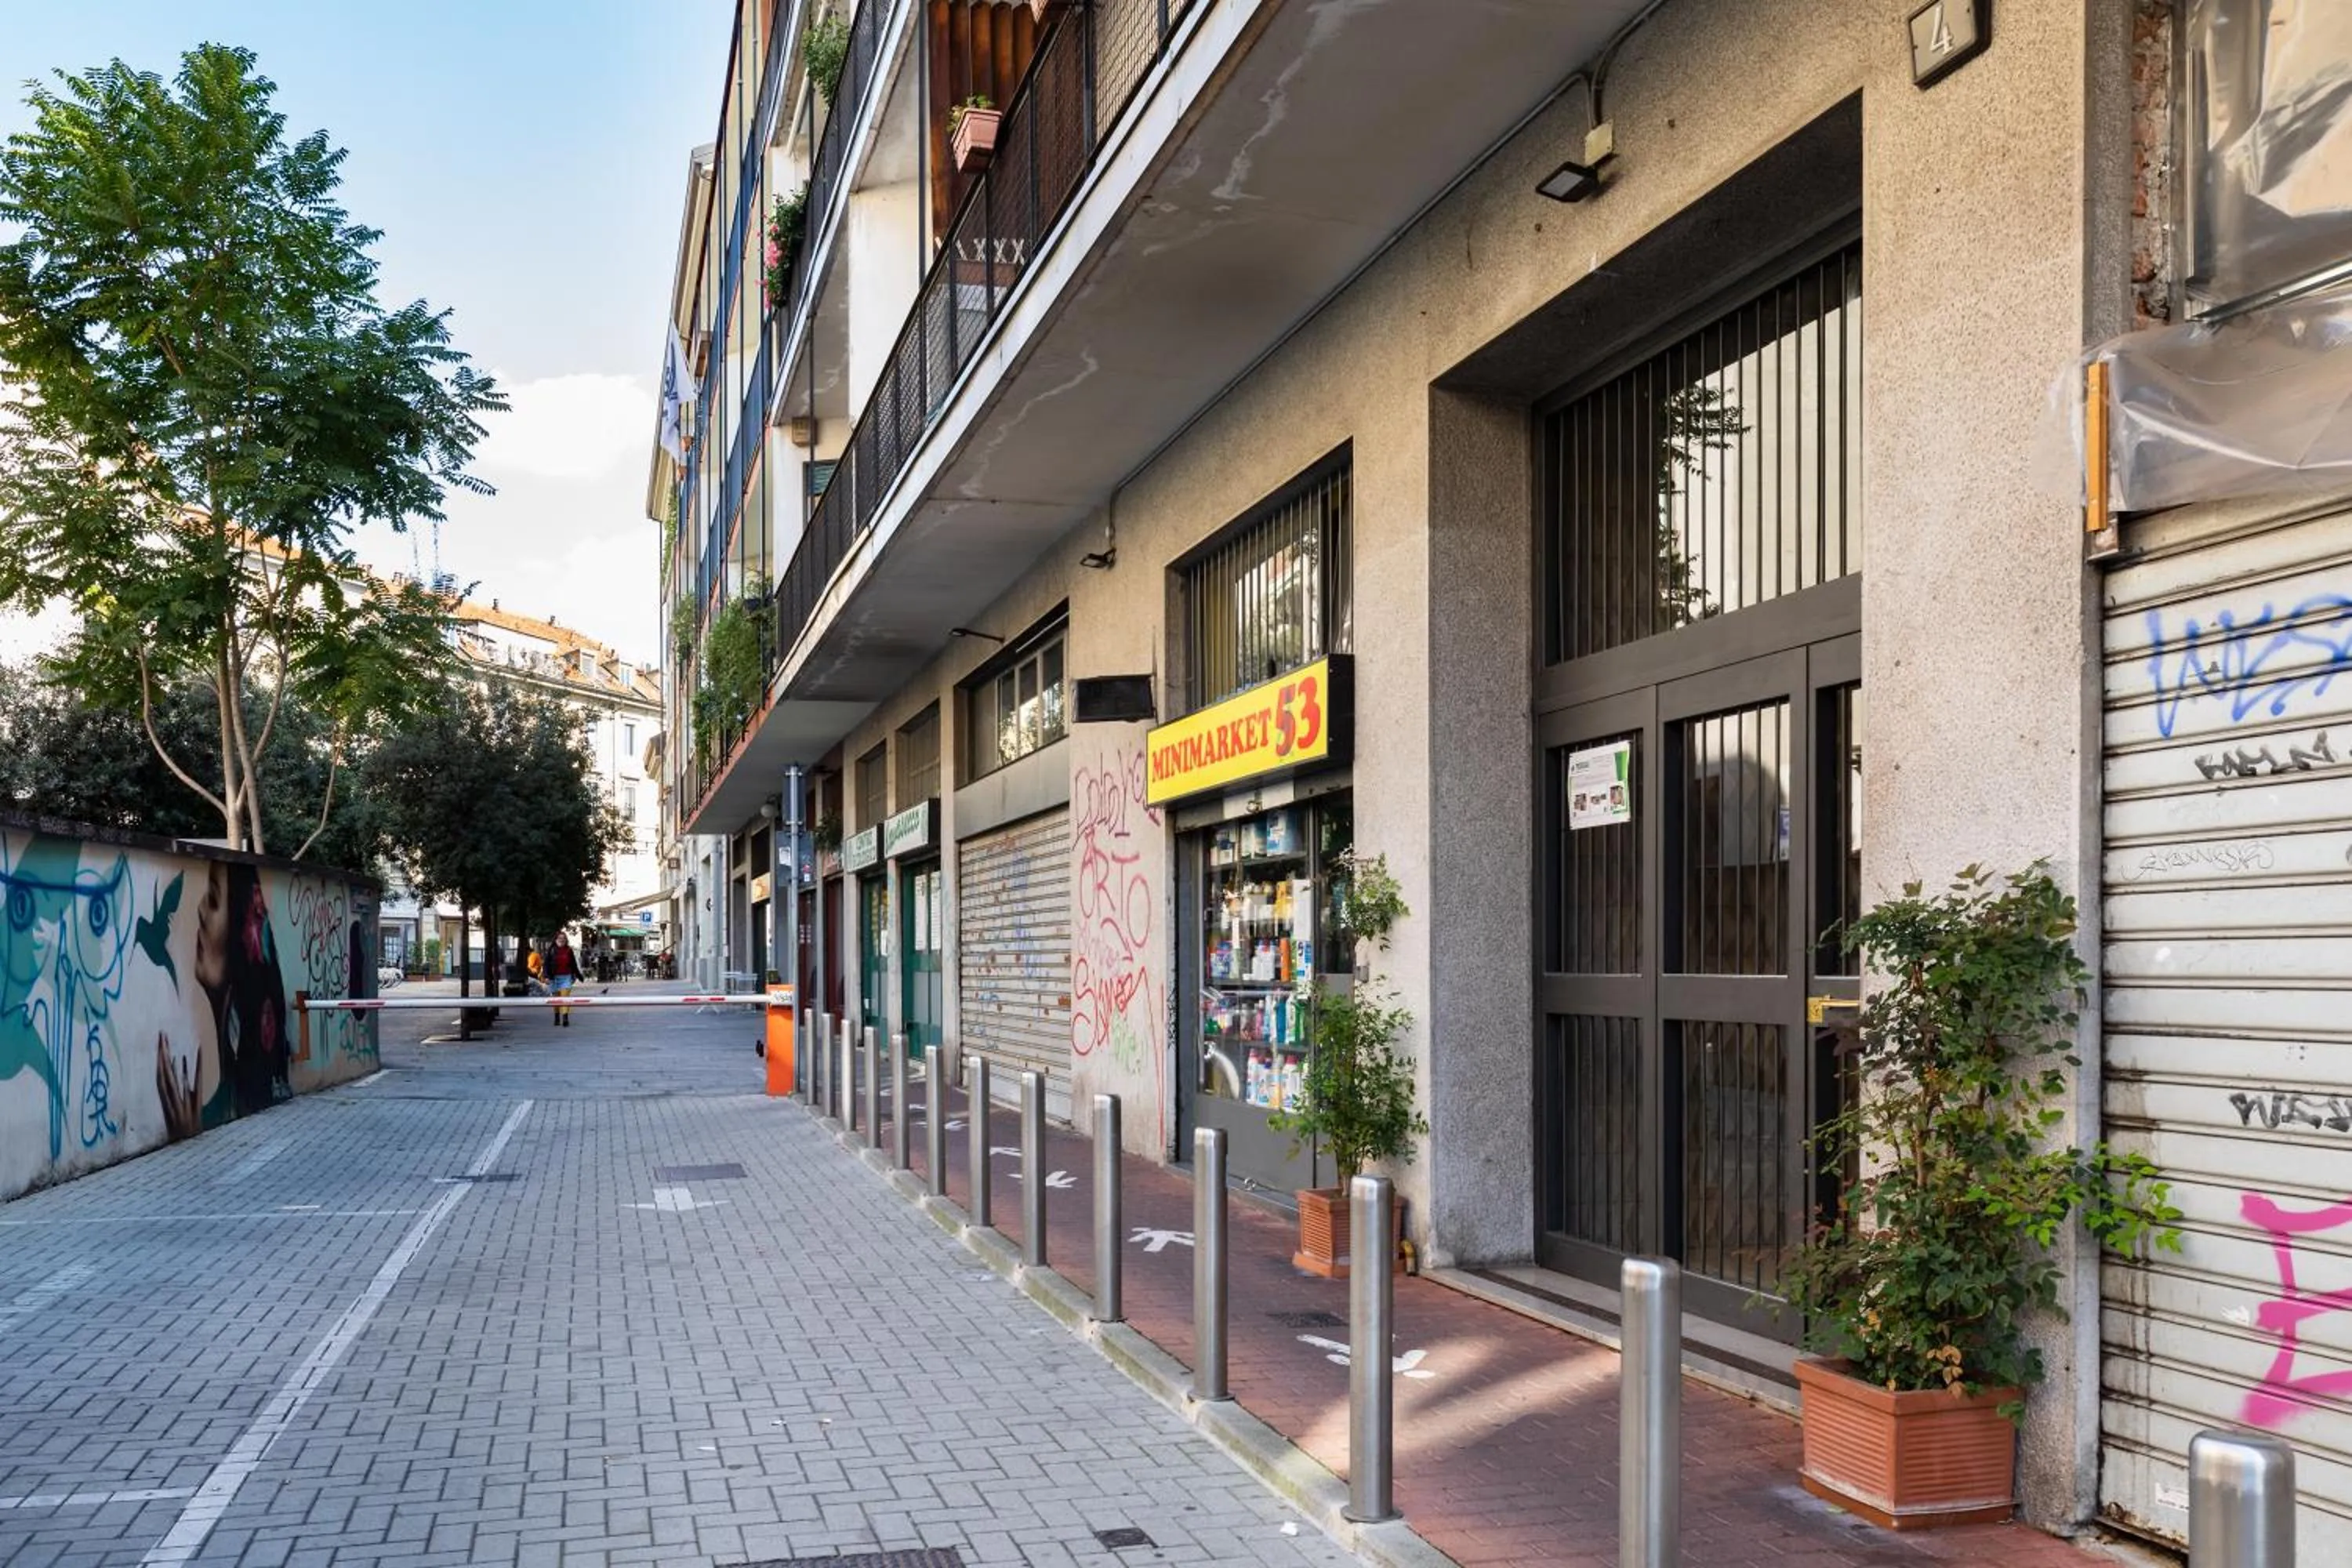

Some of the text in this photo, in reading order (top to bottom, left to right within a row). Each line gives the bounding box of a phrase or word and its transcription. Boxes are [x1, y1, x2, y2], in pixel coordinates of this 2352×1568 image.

[1929, 3, 1955, 56] 4
[1151, 675, 1322, 783] MINIMARKET 53
